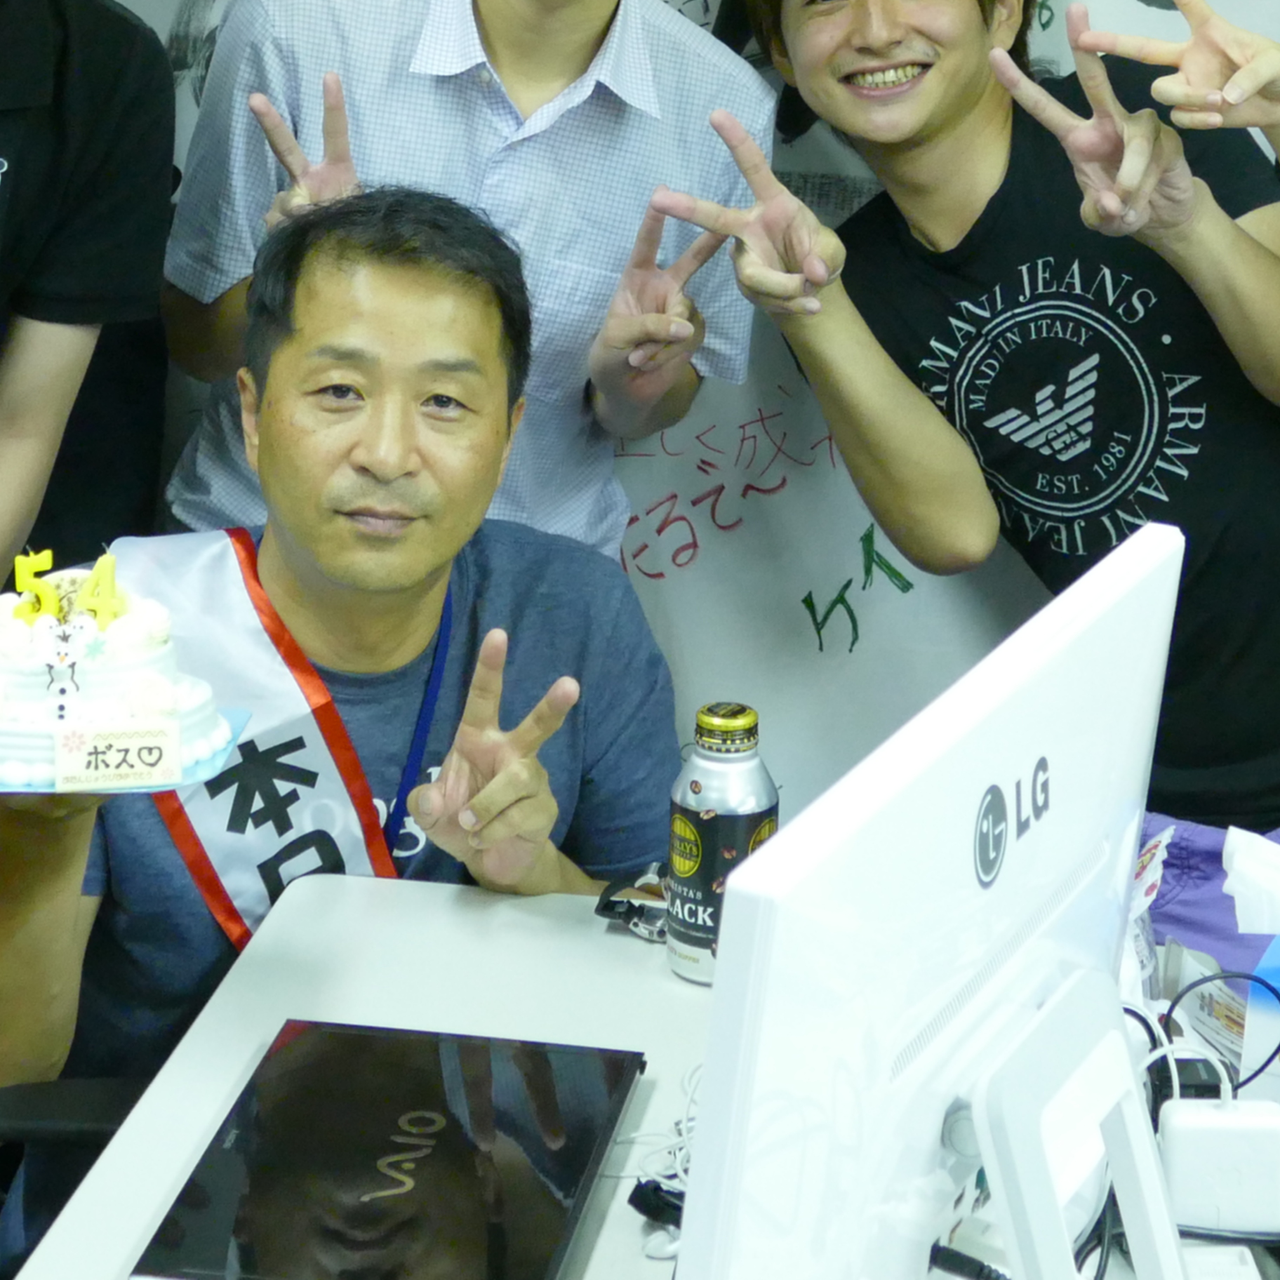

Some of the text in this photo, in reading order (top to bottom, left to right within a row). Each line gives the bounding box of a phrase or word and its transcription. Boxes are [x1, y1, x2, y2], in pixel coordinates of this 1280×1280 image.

[920, 256, 1158, 410] RMANI JEANS
[998, 328, 1023, 353] IN
[1029, 320, 1094, 348] ITALY
[1035, 430, 1132, 495] EST. 1981
[1016, 756, 1049, 842] LG
